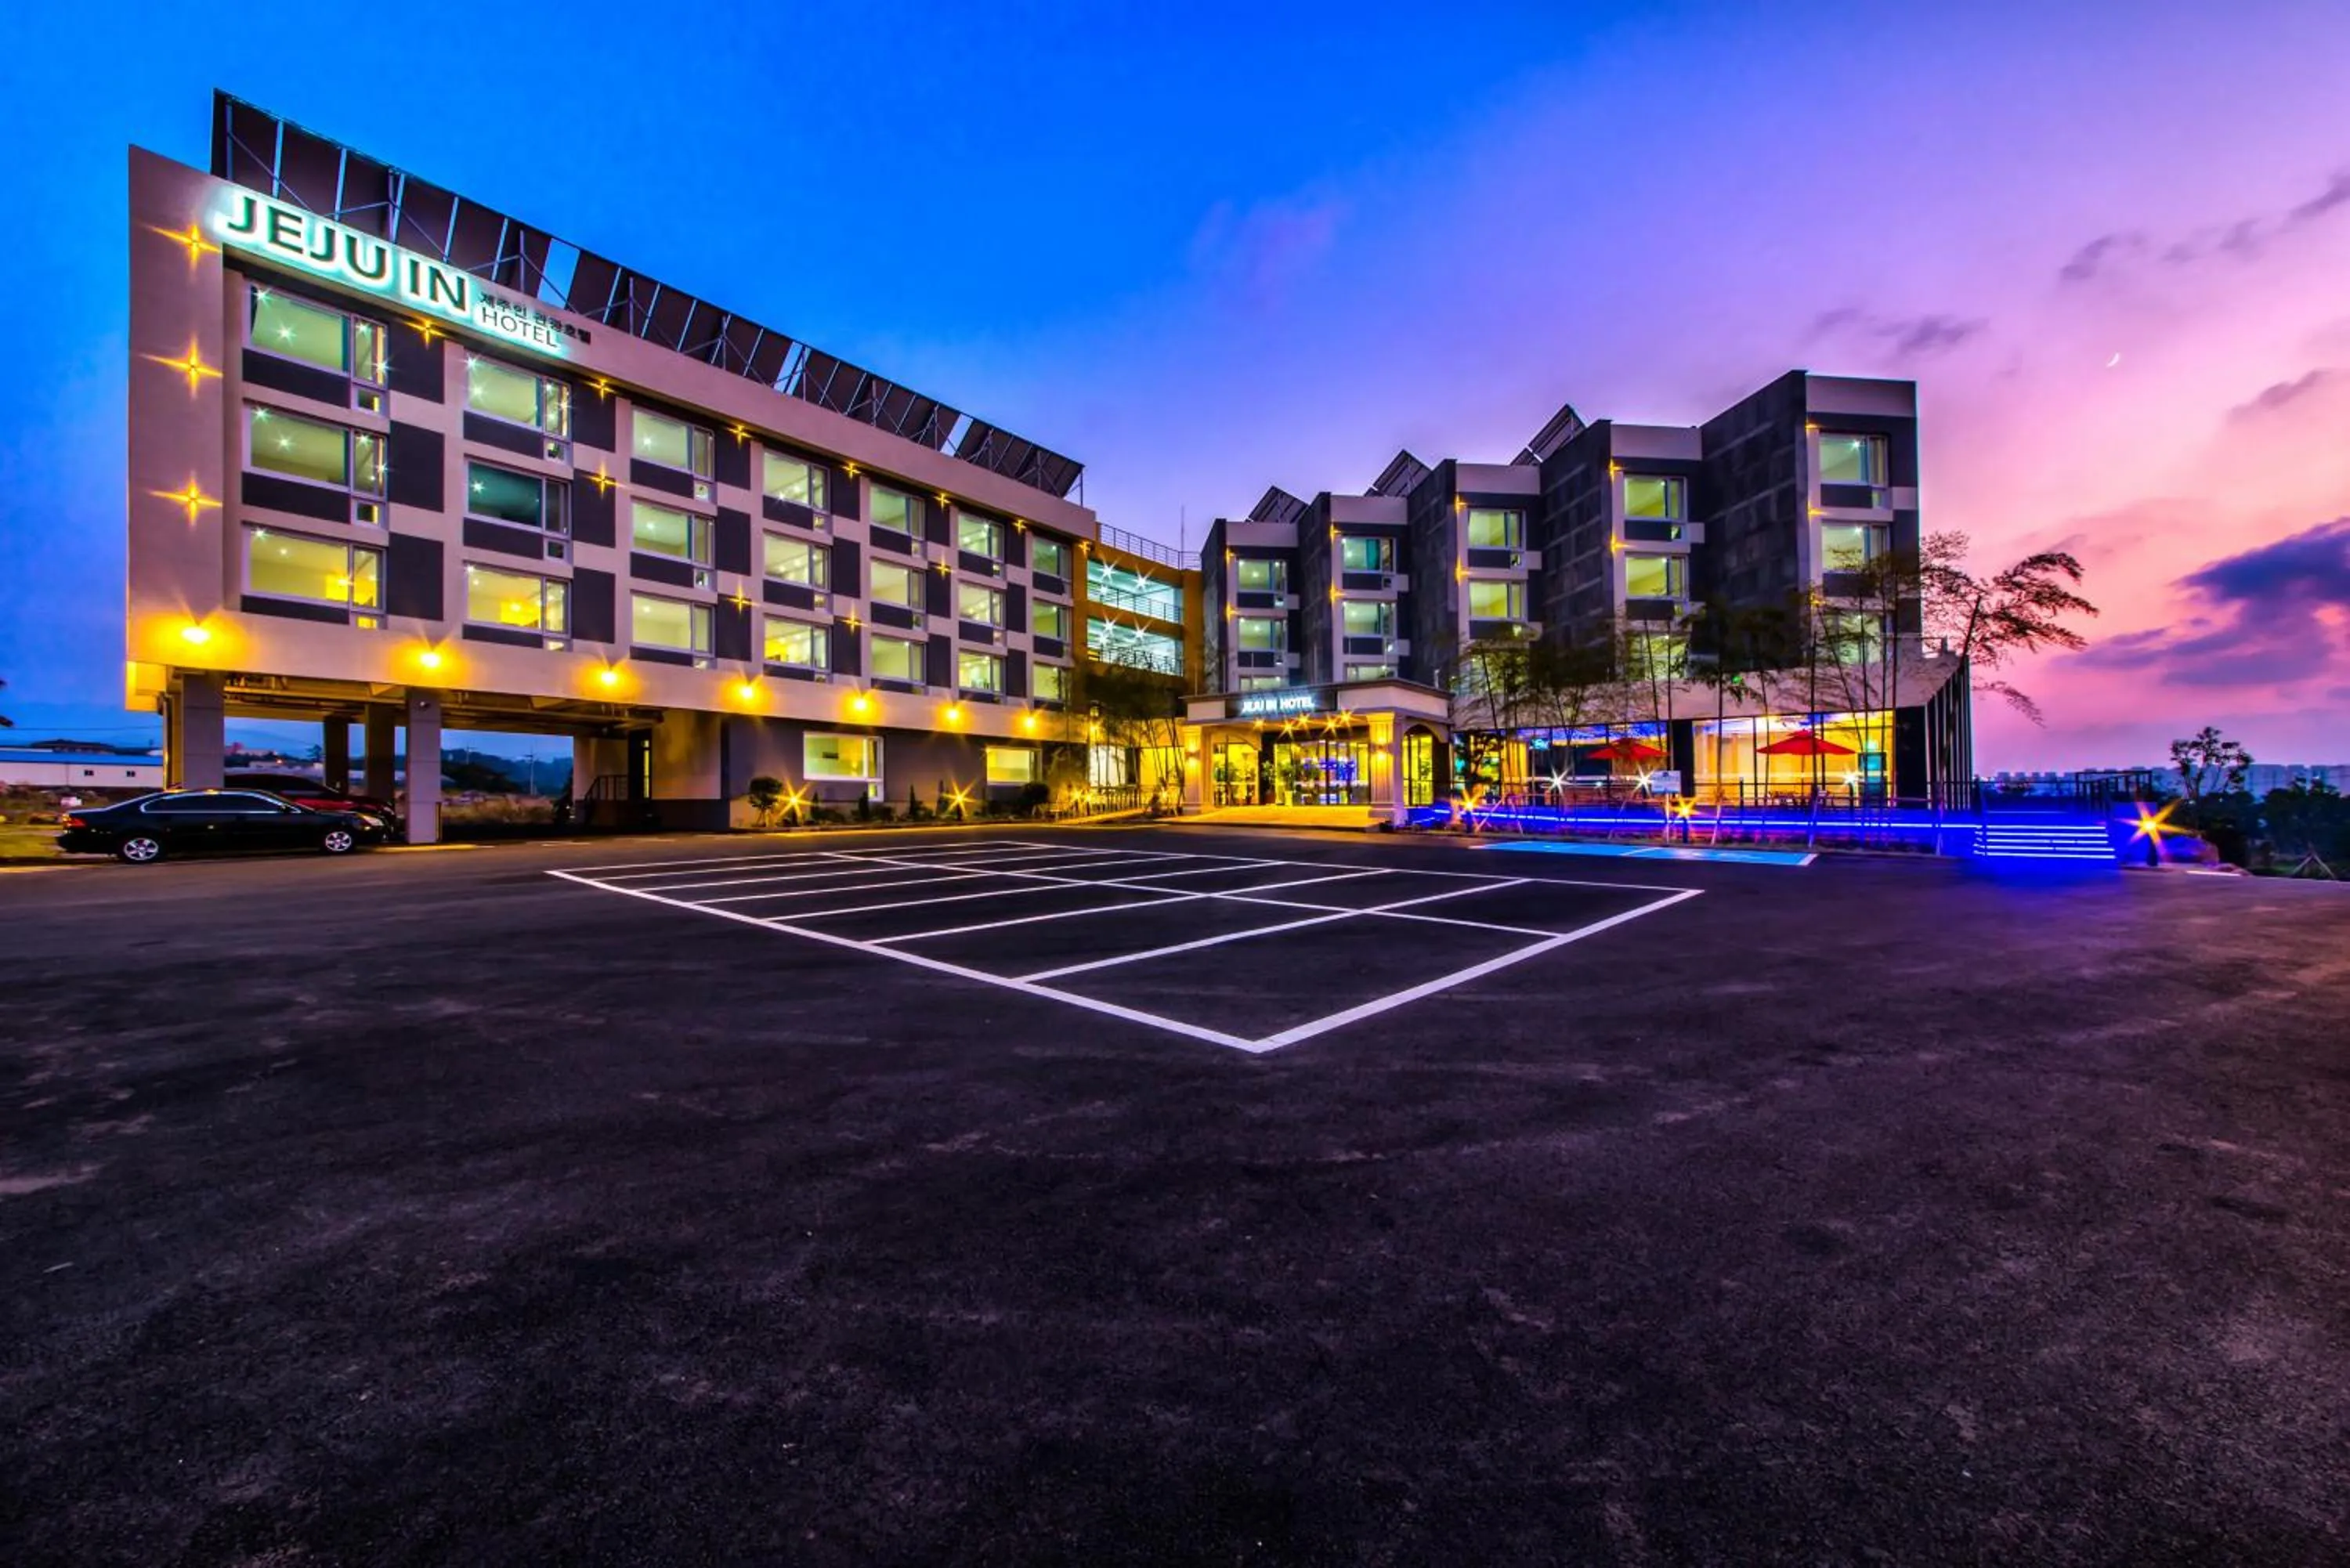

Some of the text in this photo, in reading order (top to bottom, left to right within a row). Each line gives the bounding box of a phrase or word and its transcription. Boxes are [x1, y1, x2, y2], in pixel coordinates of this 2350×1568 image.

[227, 196, 466, 312] JEJU IN
[482, 306, 558, 348] HOTEL
[1280, 696, 1314, 710] HOTEL
